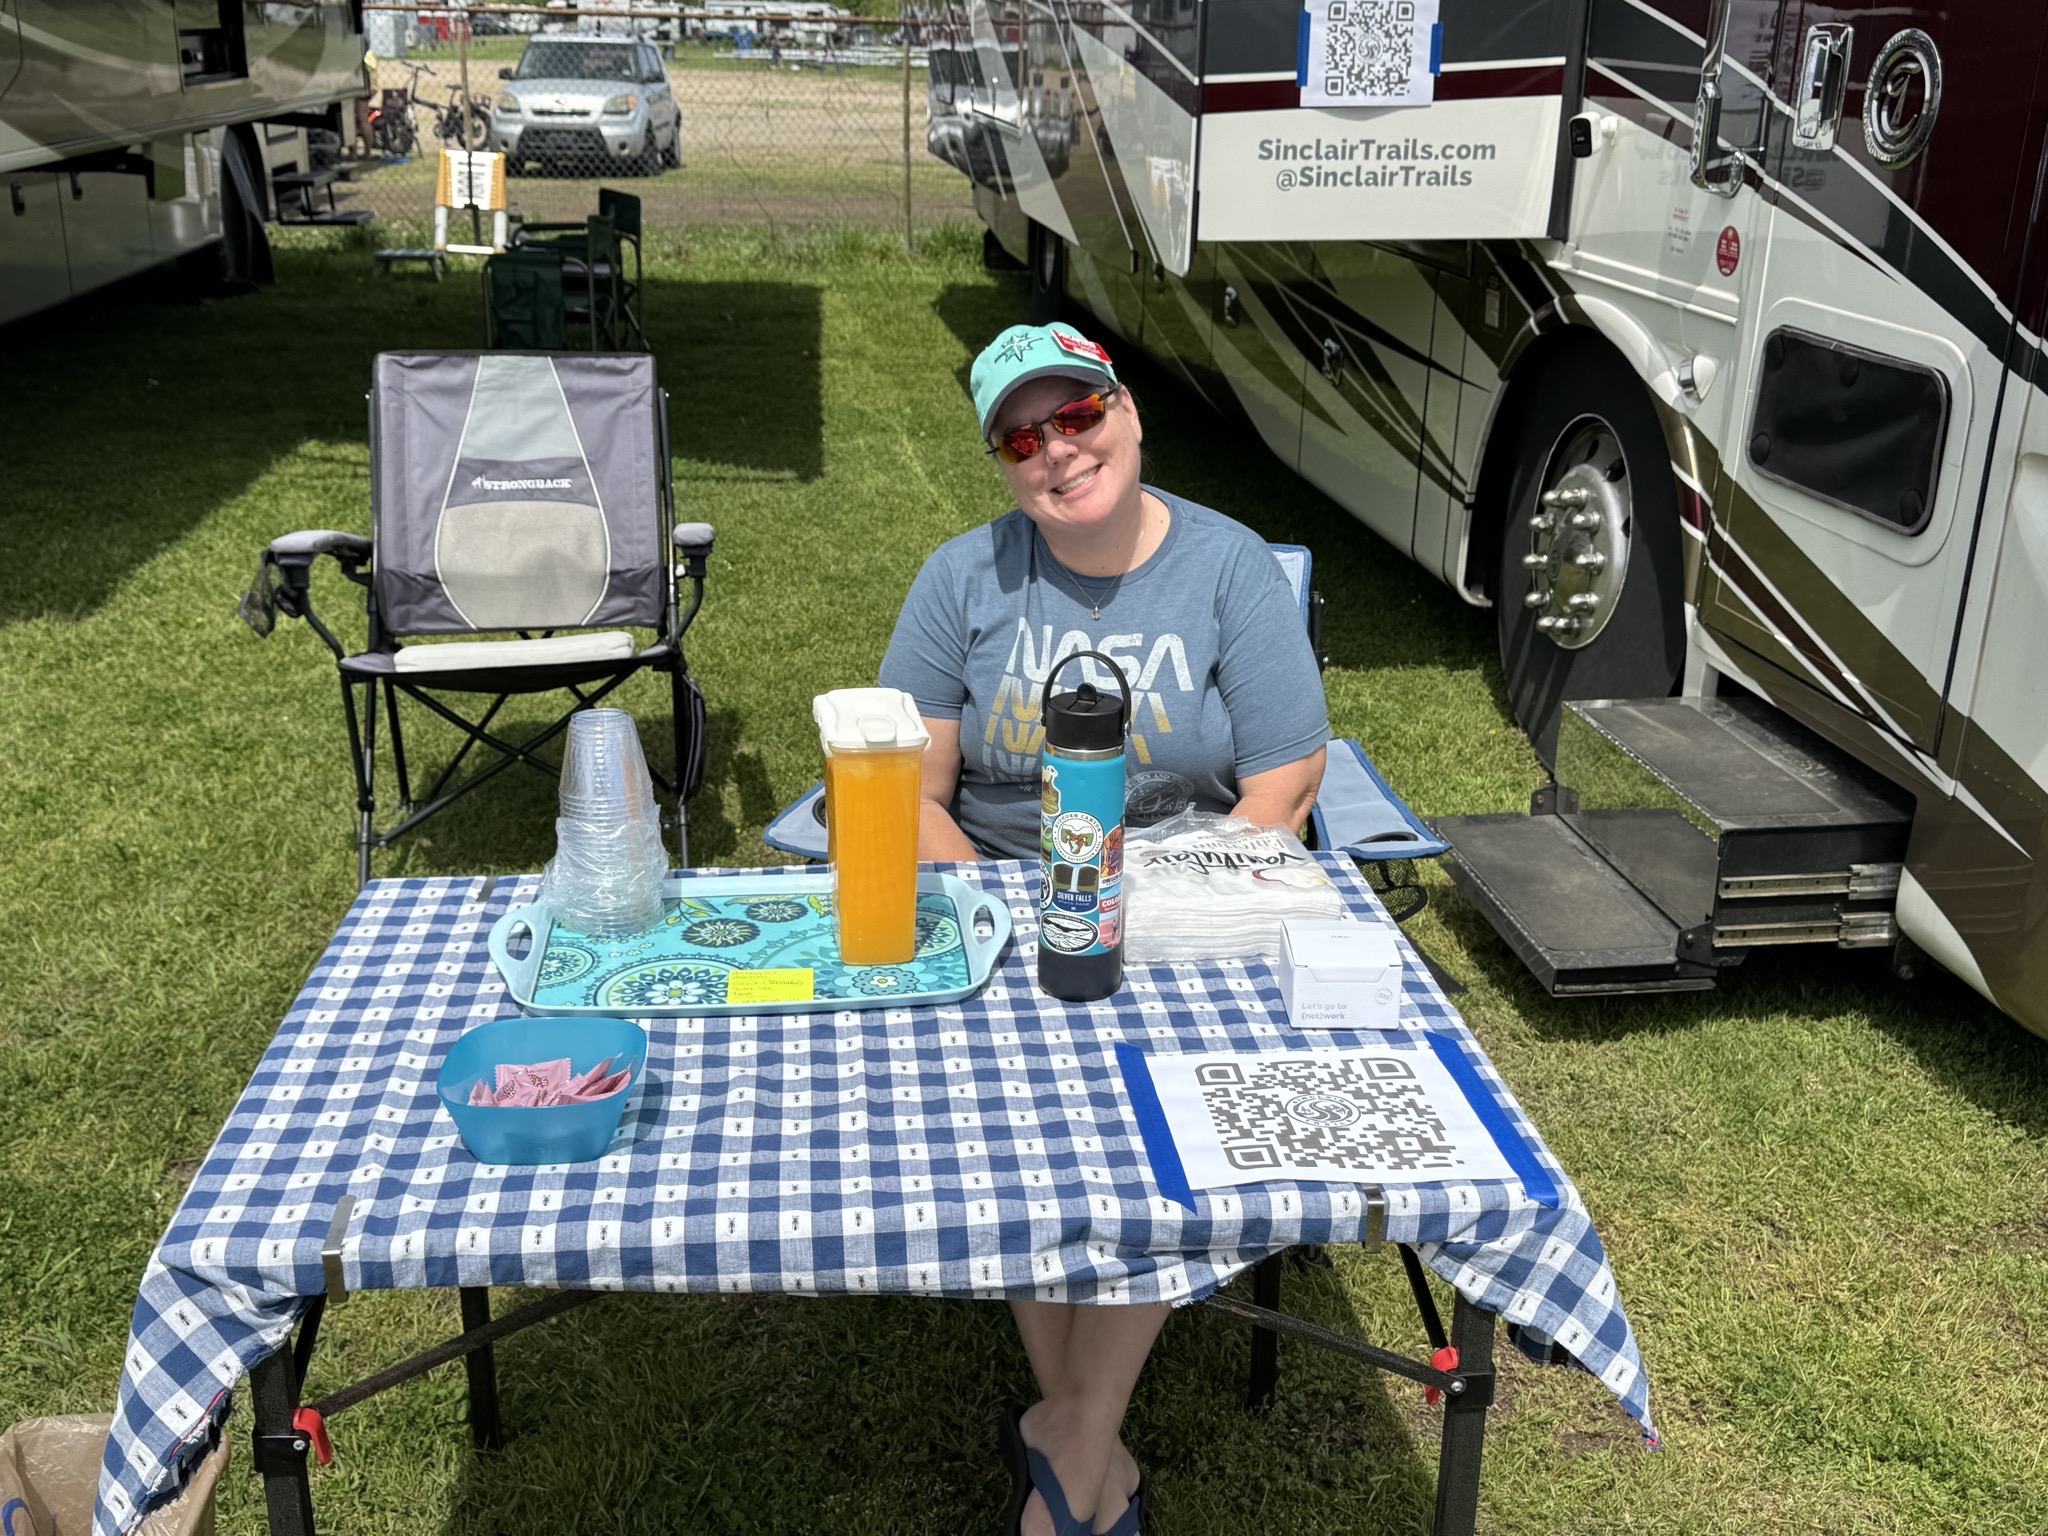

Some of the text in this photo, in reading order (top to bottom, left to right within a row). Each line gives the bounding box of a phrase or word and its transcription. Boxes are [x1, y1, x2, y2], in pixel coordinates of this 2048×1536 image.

[1258, 138, 1497, 161] SinclairTrails.com
[1276, 165, 1473, 191] @SinclairTrails
[483, 478, 573, 491] STRONGBACK
[1004, 616, 1195, 692] NASA
[1057, 891, 1092, 903] SILVER FALLS
[1301, 1002, 1323, 1010] Let's
[1301, 1011, 1346, 1020] (net)work
